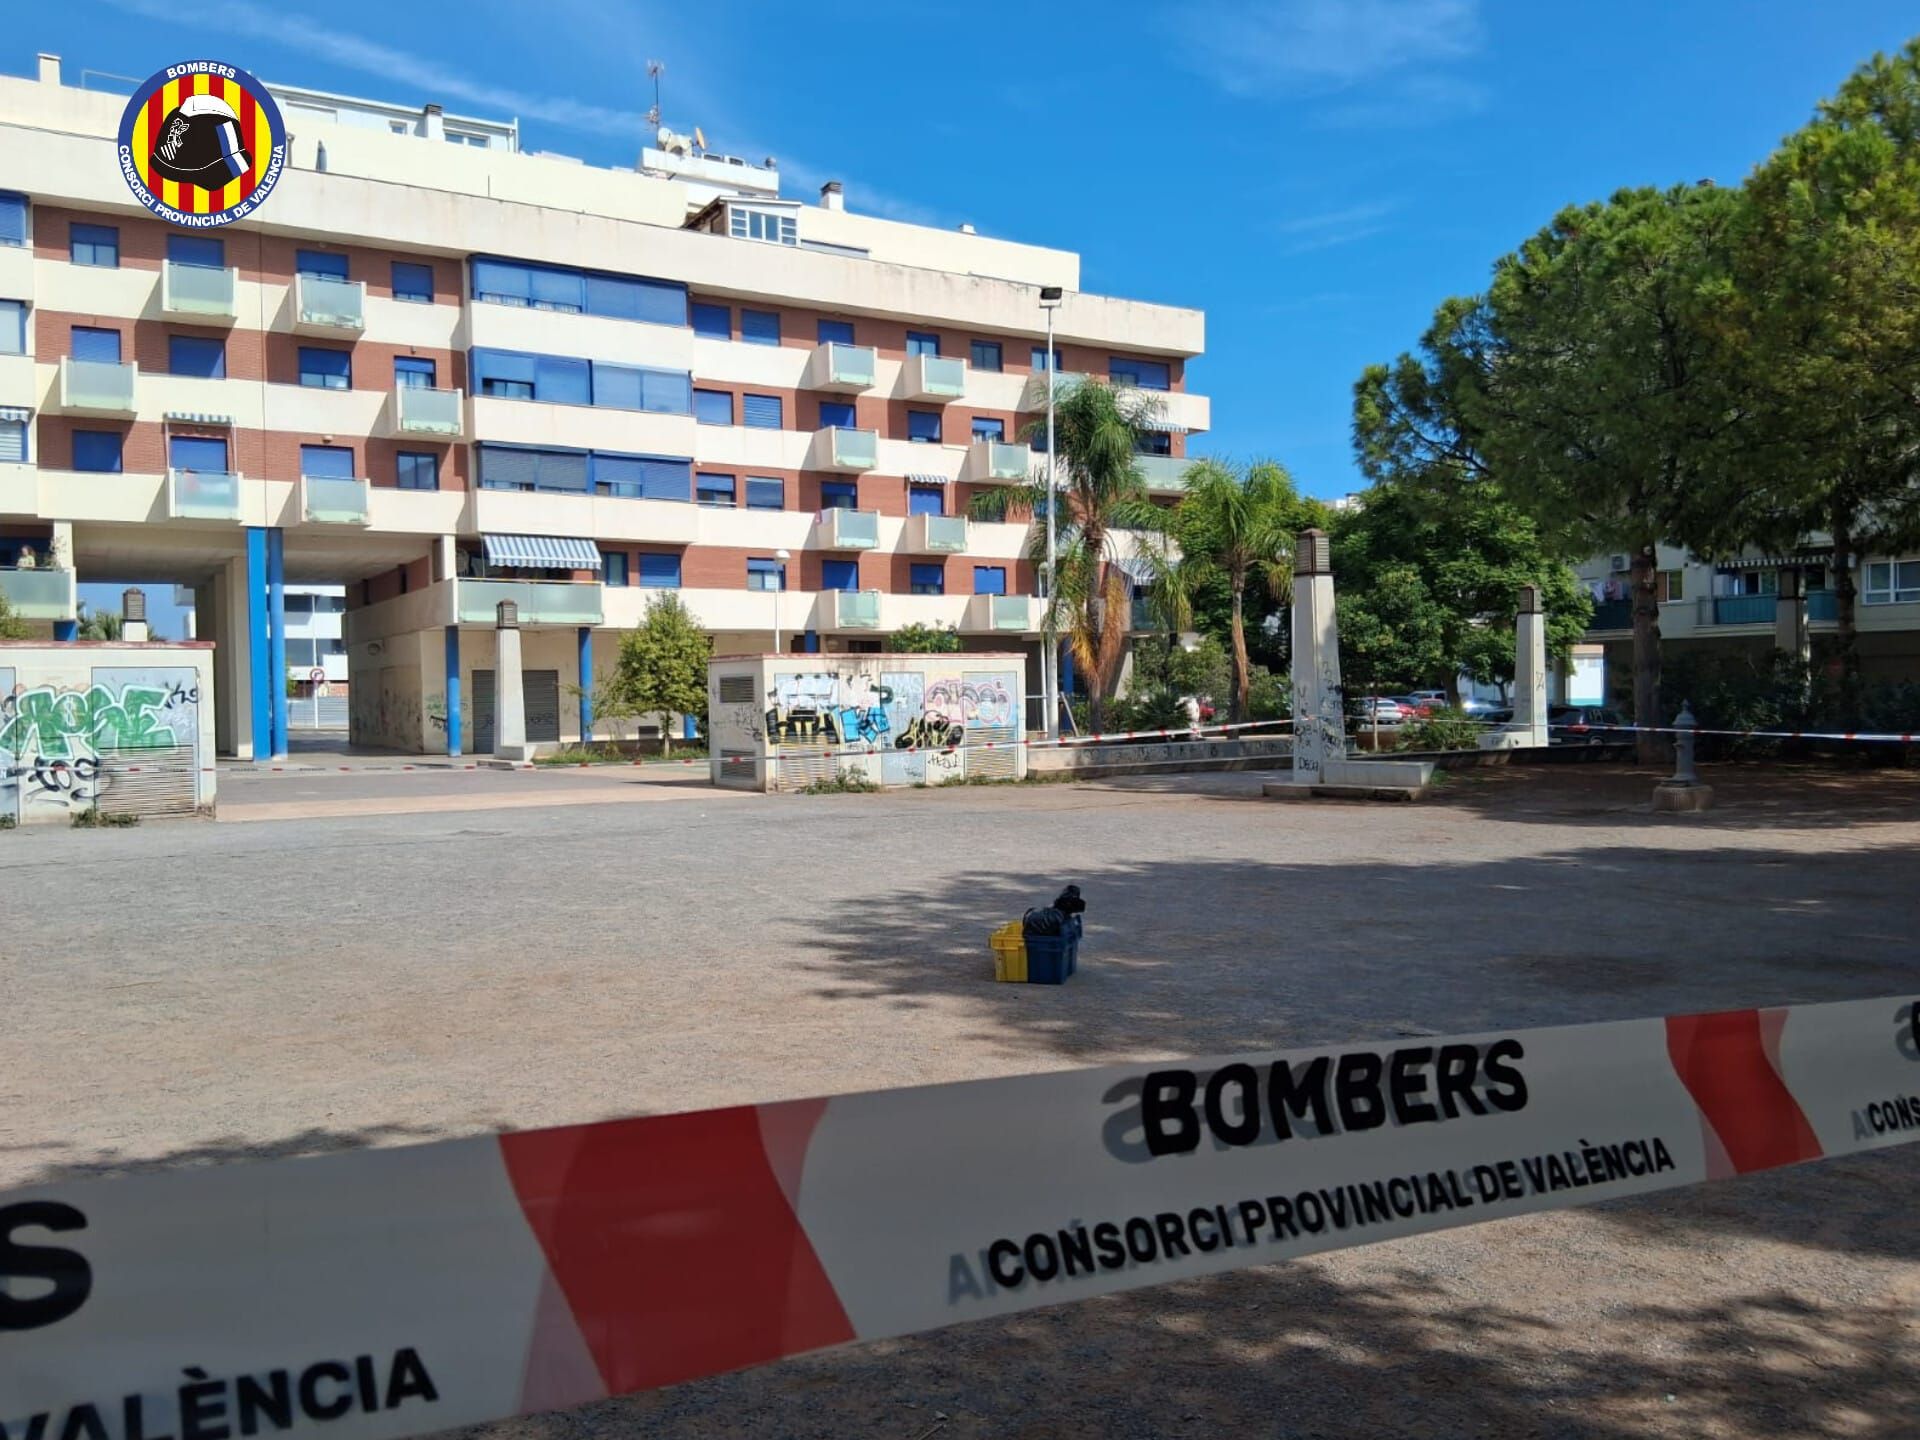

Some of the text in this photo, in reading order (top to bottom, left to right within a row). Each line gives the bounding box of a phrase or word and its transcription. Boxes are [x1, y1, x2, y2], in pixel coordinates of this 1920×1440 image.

[1141, 1039, 1529, 1157] BOMBERS
[987, 1205, 1234, 1289] CONSORCI
[1243, 1166, 1475, 1244] PROVINCIAL
[1472, 1156, 1525, 1204] DE
[1521, 1136, 1677, 1194] VALÈNCIA
